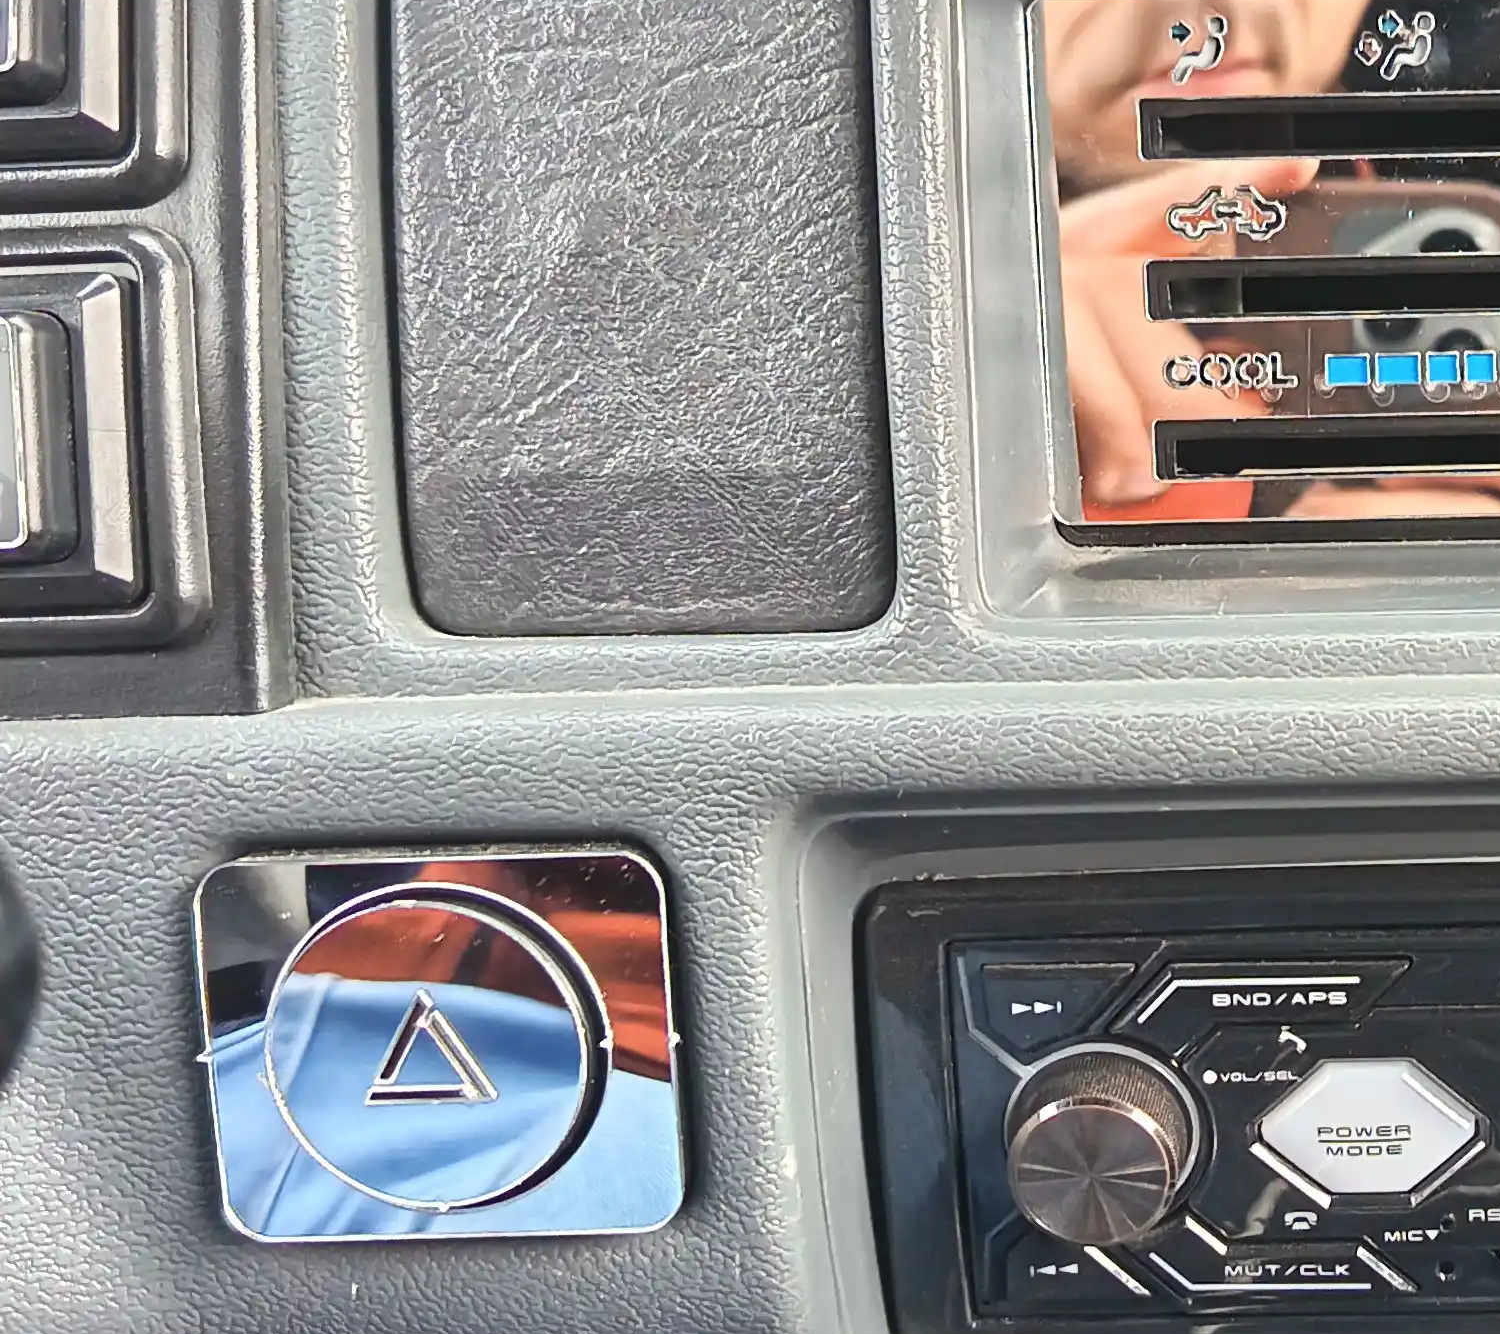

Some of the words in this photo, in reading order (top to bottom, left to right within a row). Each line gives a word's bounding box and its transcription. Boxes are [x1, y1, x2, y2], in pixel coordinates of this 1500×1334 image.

[1163, 352, 1298, 390] COOL
[1212, 990, 1348, 1007] BND/APS
[1317, 1124, 1412, 1138] POWER
[1325, 1143, 1403, 1157] MODE
[1383, 1229, 1424, 1243] MIC
[1224, 1263, 1350, 1277] MUT/CLK
